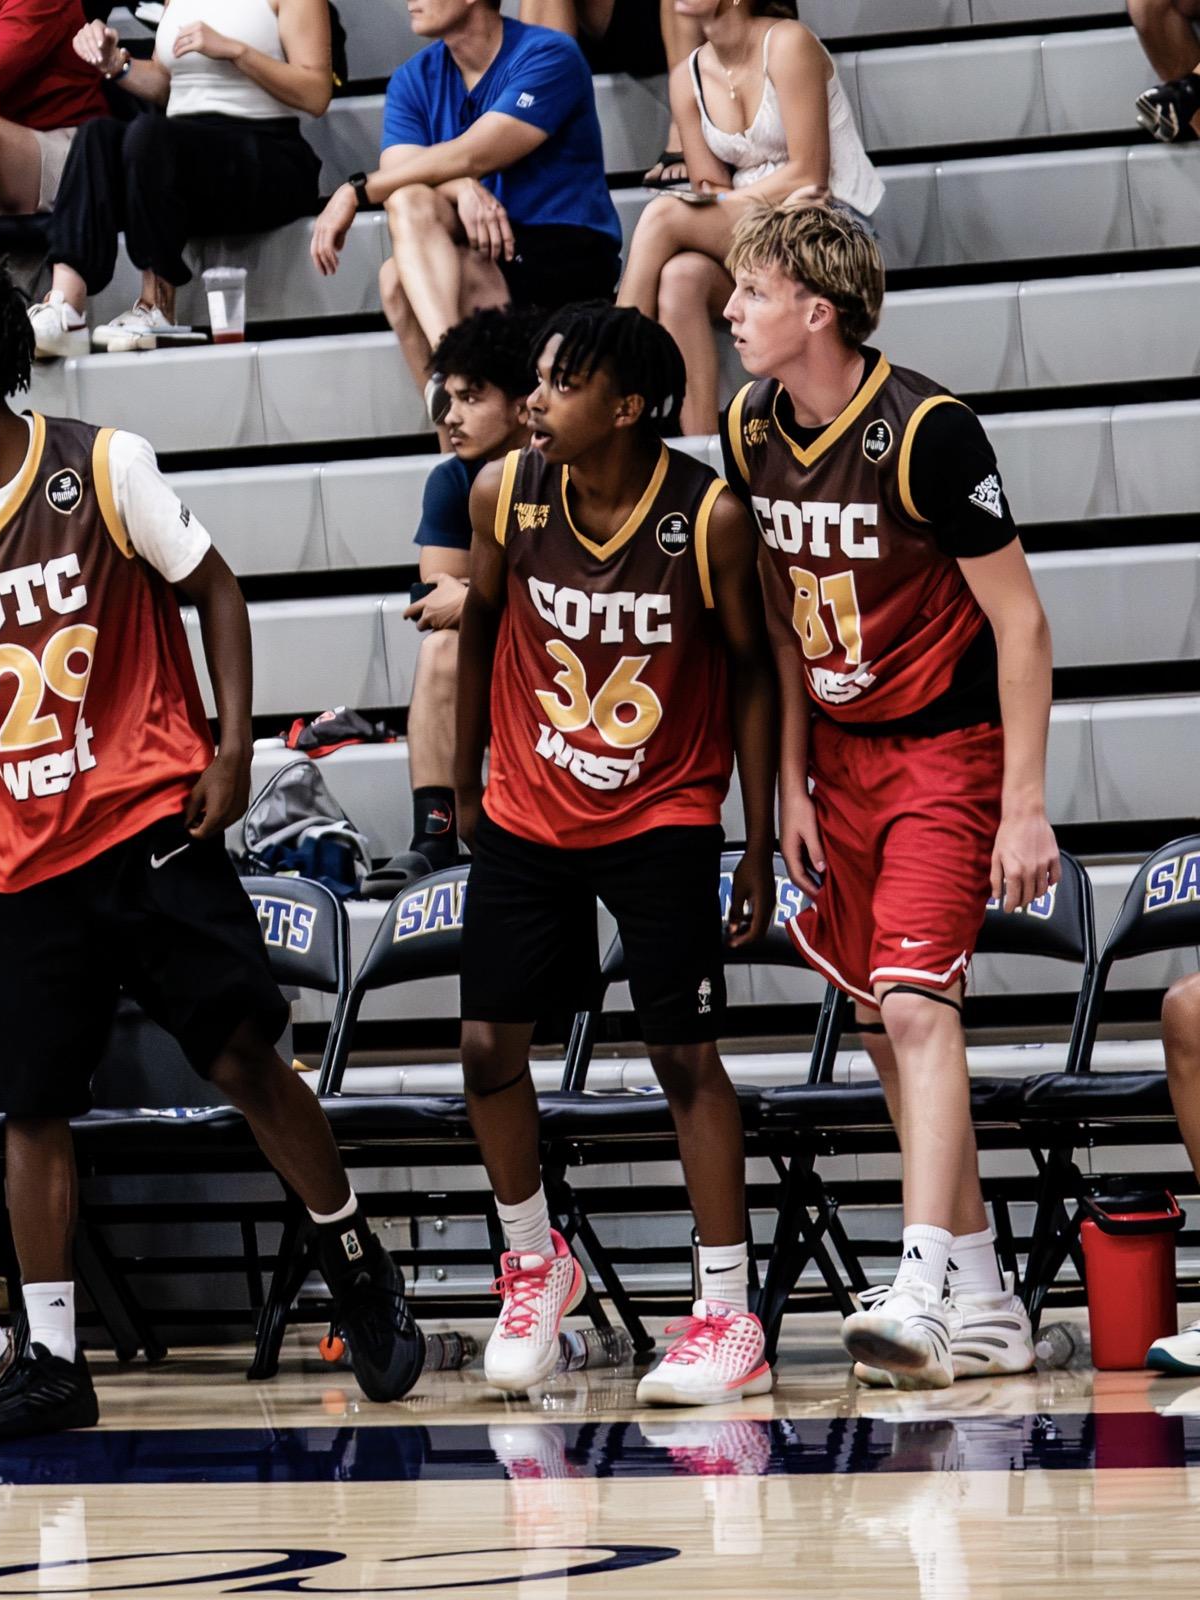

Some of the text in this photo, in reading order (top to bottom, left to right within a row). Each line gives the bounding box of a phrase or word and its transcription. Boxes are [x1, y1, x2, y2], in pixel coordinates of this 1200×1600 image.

[751, 495, 880, 559] COTC
[527, 576, 672, 645] COTC
[788, 565, 863, 666] 81
[534, 638, 663, 750] 36
